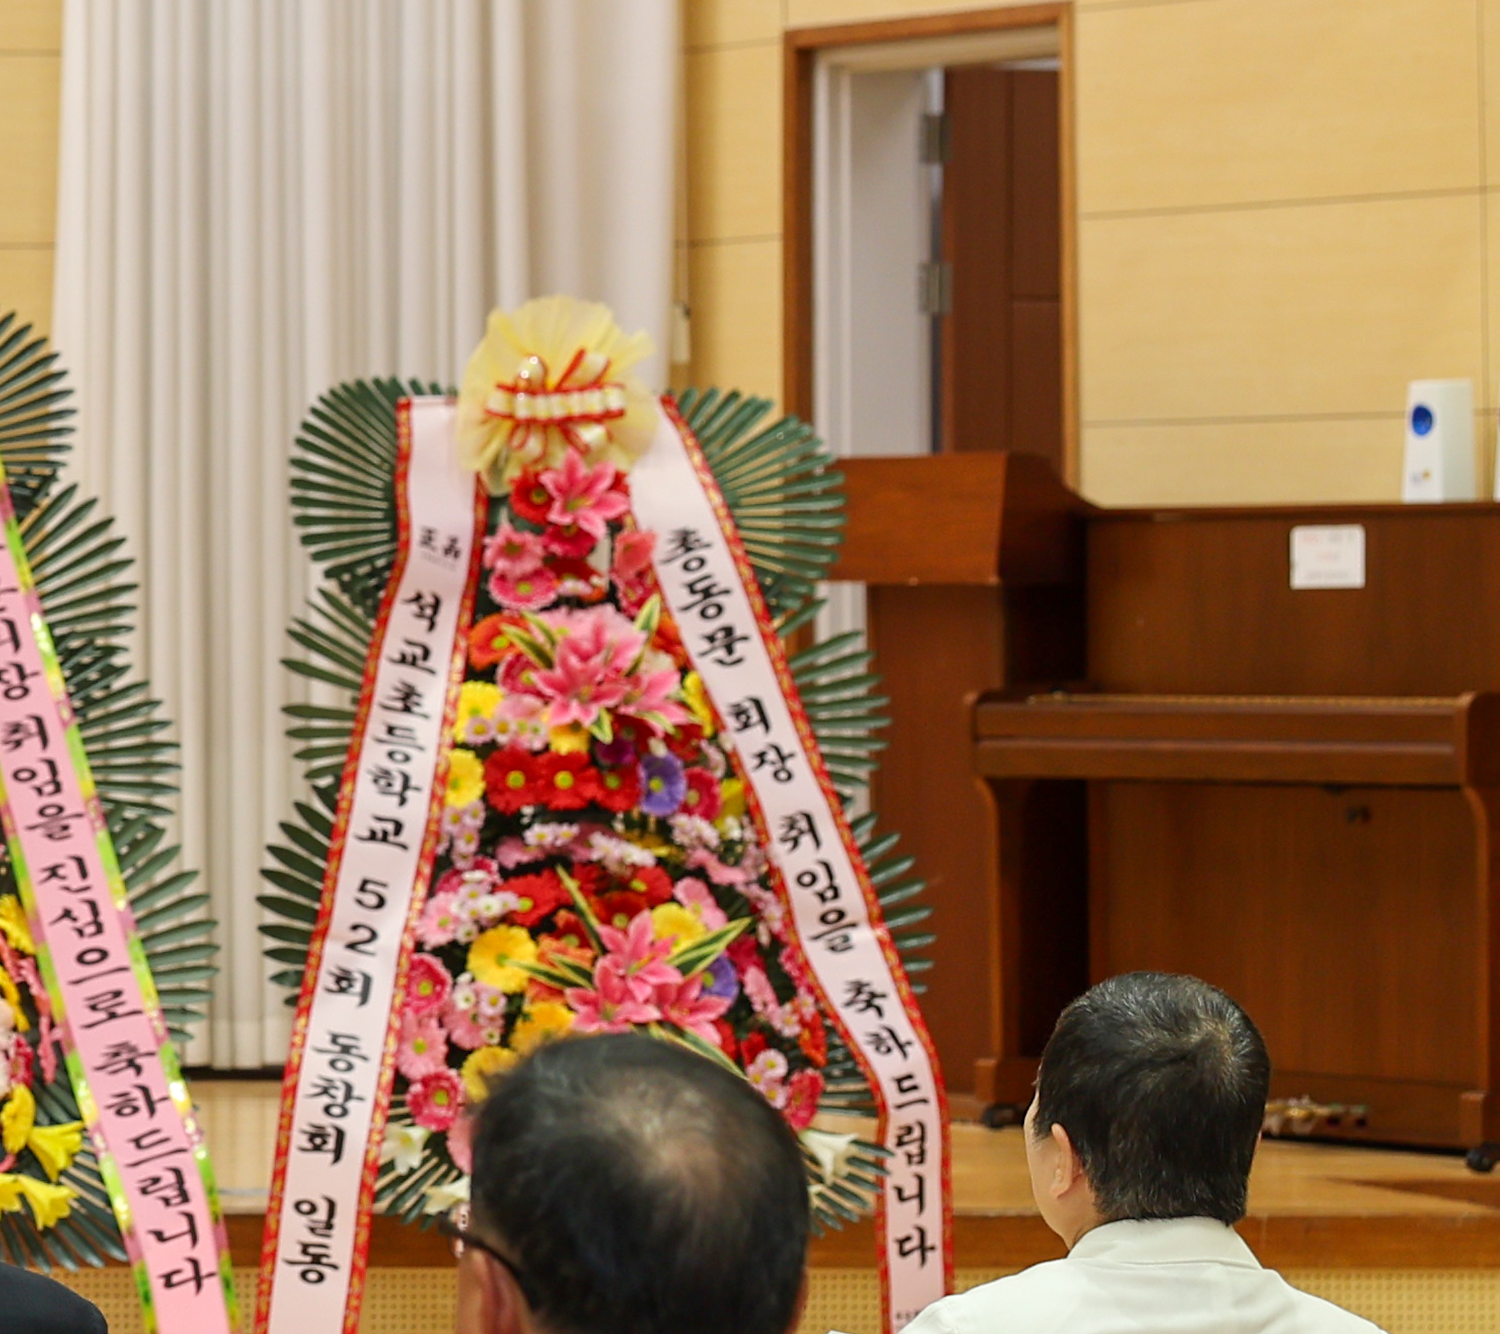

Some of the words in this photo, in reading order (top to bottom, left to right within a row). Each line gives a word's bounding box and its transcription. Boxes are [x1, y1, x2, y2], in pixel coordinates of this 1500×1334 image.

[0, 714, 86, 842] 취임을
[353, 588, 442, 852] 석교초등학교
[37, 854, 144, 1030] 진심으로
[321, 878, 390, 1008] 52회
[296, 1030, 370, 1166] 동창회
[775, 809, 861, 955] 취임을
[841, 978, 938, 1269] 축하드립니다
[93, 1040, 218, 1298] 축하드립니다
[281, 1195, 340, 1286] 일동
